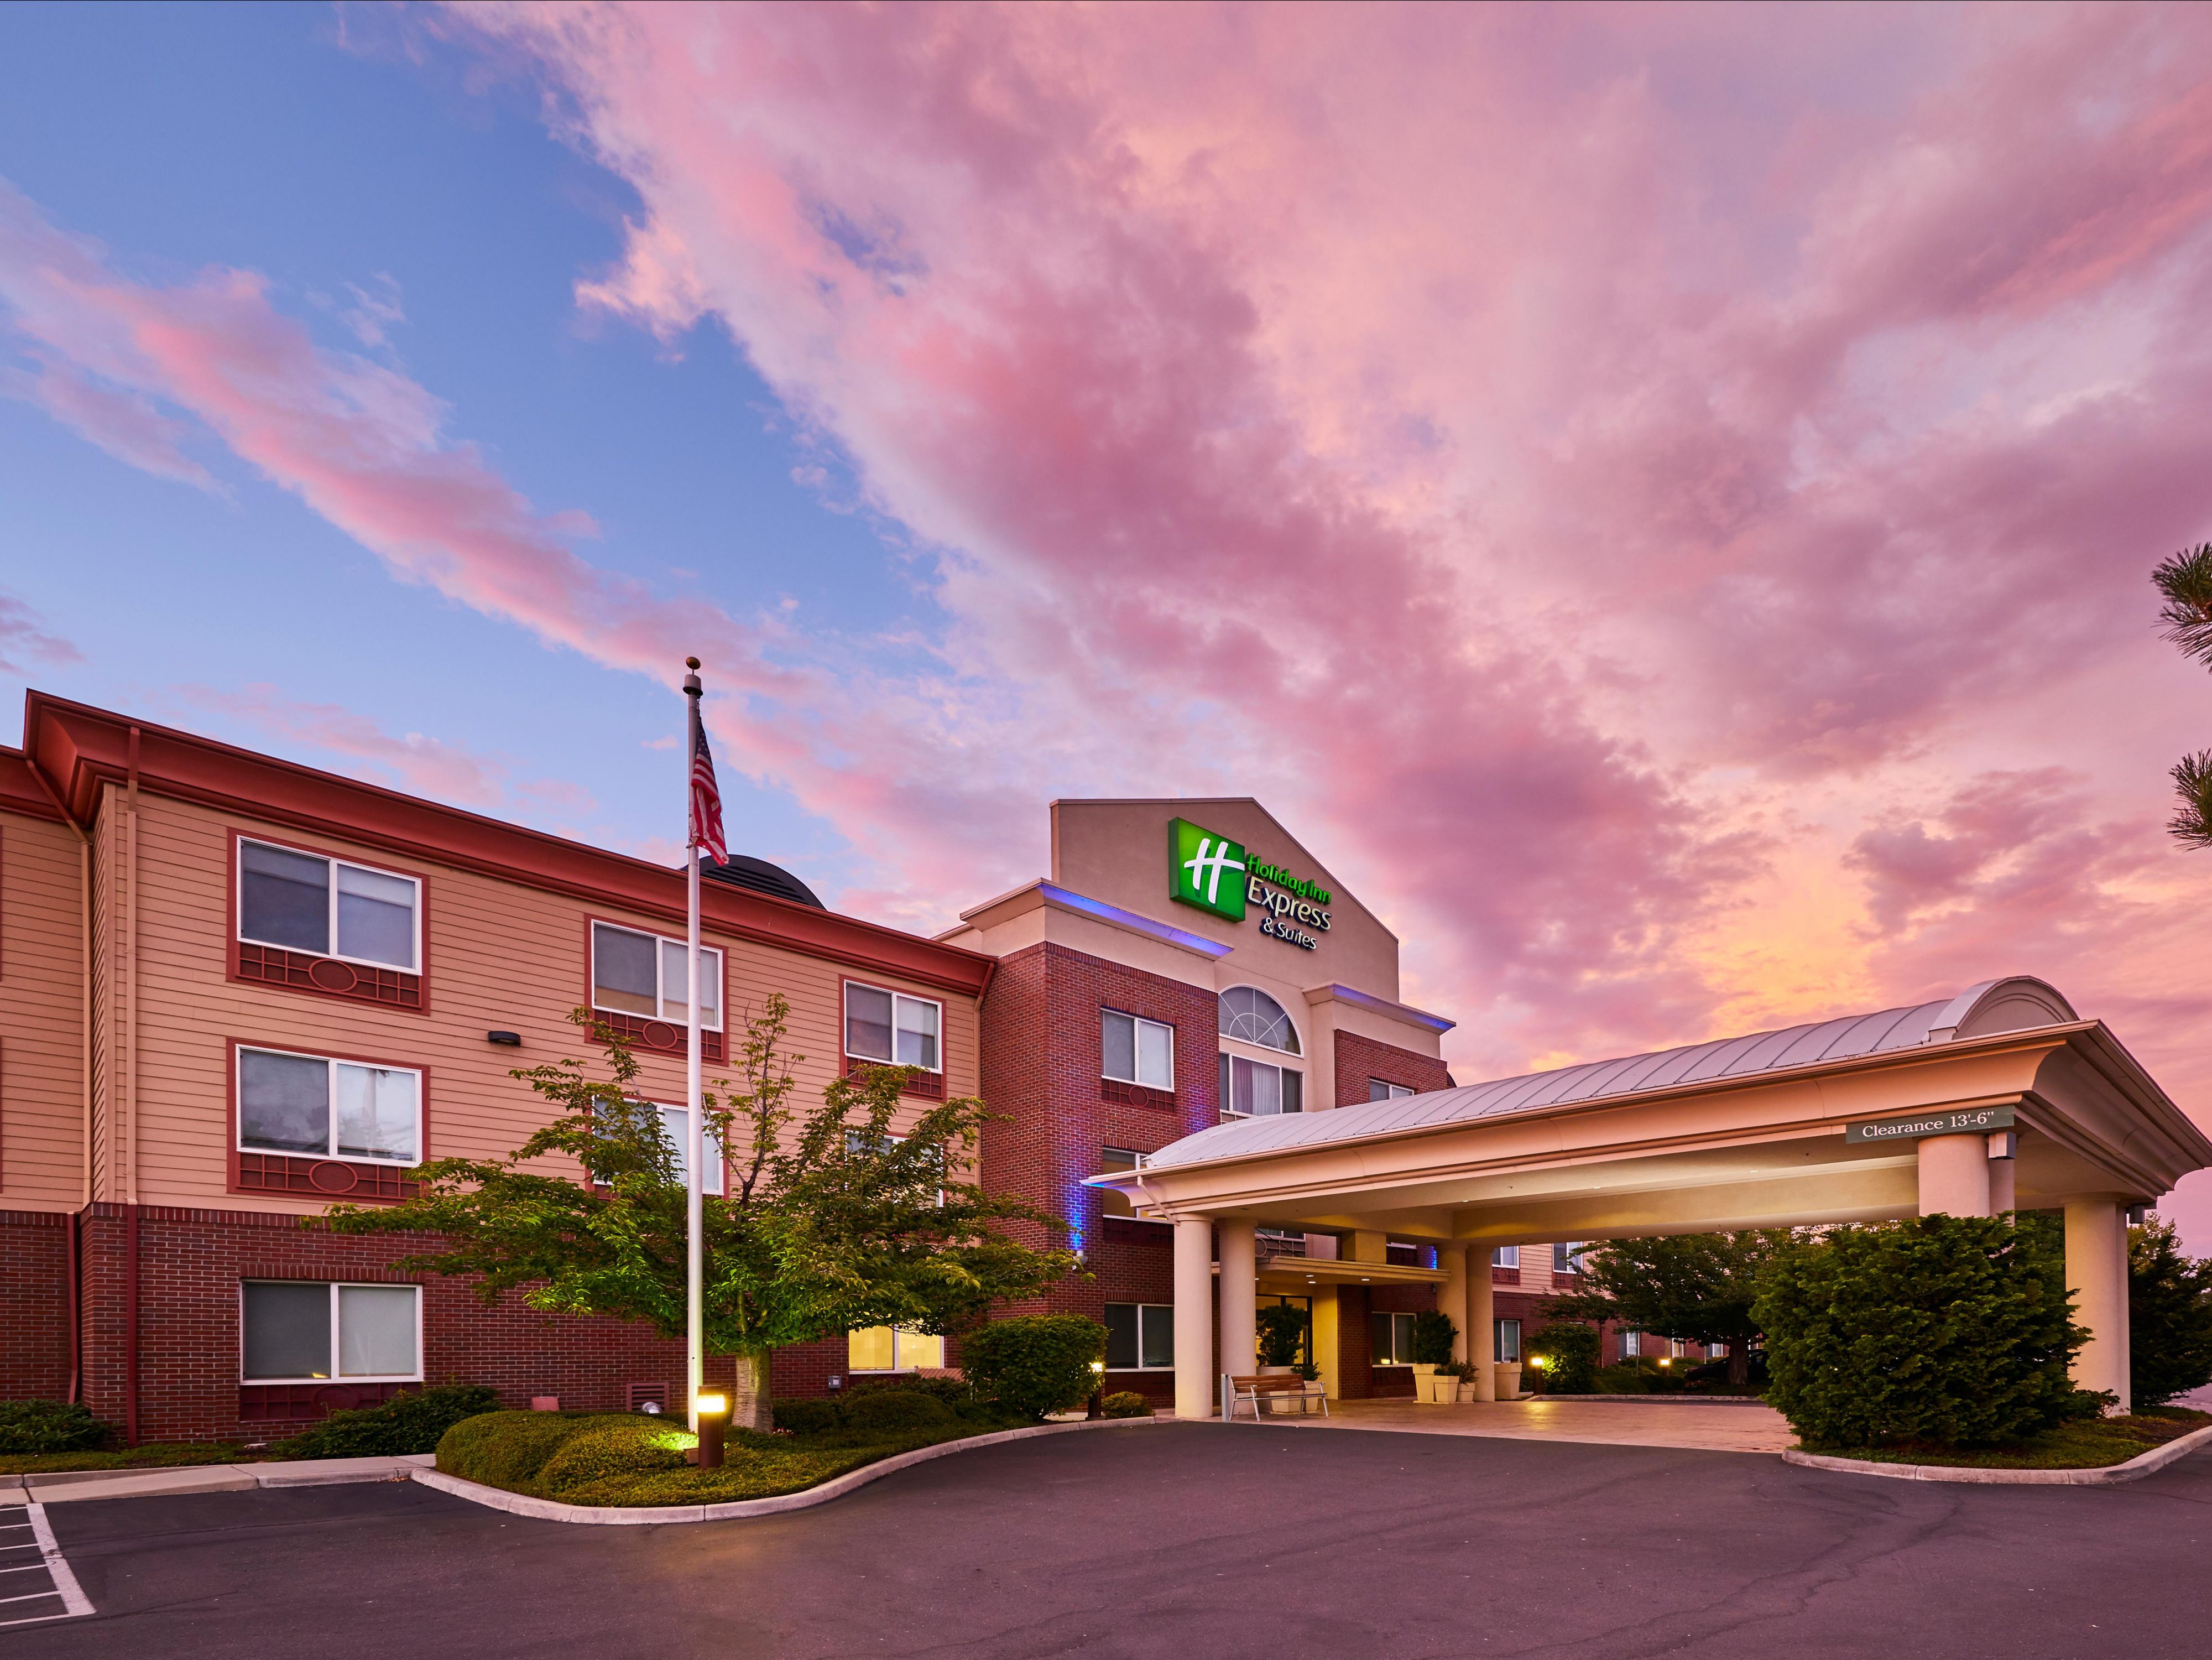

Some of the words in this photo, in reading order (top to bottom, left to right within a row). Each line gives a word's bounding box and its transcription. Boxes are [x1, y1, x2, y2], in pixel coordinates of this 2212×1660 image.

[1246, 853, 1307, 897] Holiday
[1310, 879, 1332, 904] Inn
[1248, 876, 1332, 930] Express
[1263, 917, 1274, 934] &
[1276, 922, 1317, 949] Suites
[1862, 1120, 1944, 1138] Clearance
[1950, 1111, 1994, 1128] 13'-6"
